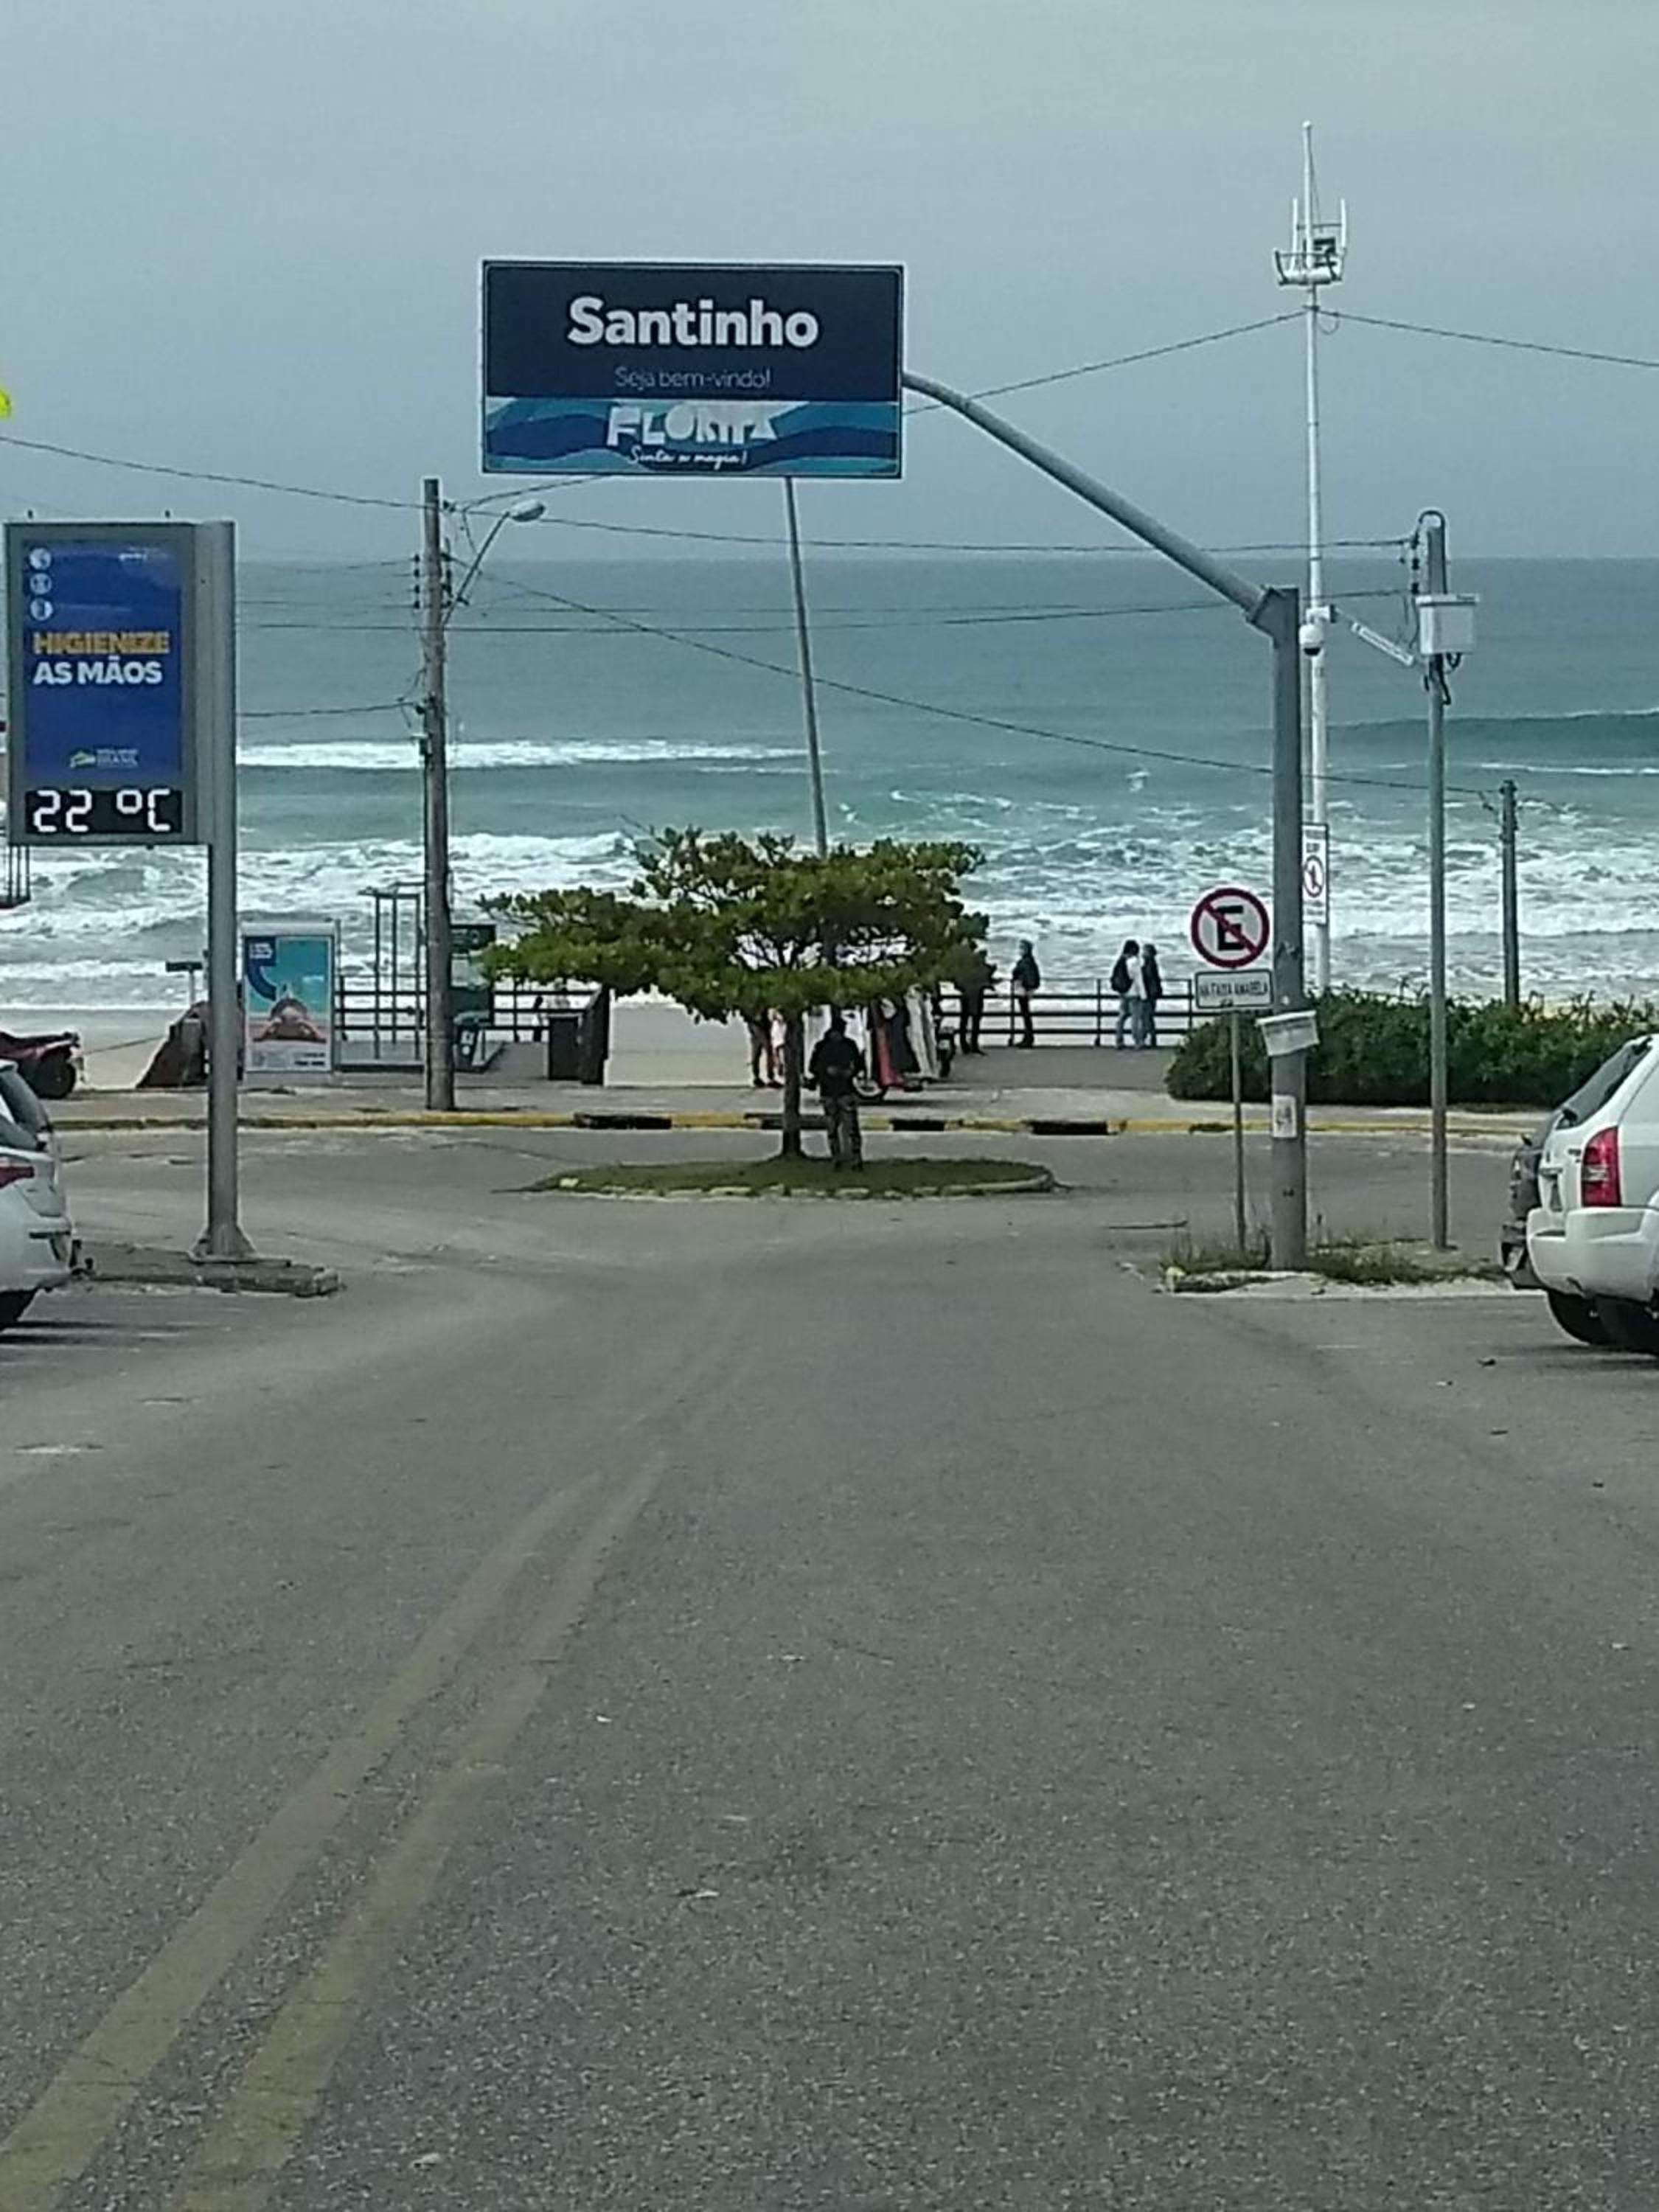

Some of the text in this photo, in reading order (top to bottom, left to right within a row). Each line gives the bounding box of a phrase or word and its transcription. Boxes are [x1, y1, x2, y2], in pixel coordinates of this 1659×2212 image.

[568, 296, 818, 347] Santinho
[615, 366, 771, 392] Seja bem-vindo!
[33, 655, 164, 684] AS MÃOS
[33, 789, 92, 833] 22
[1217, 905, 1244, 951] E
